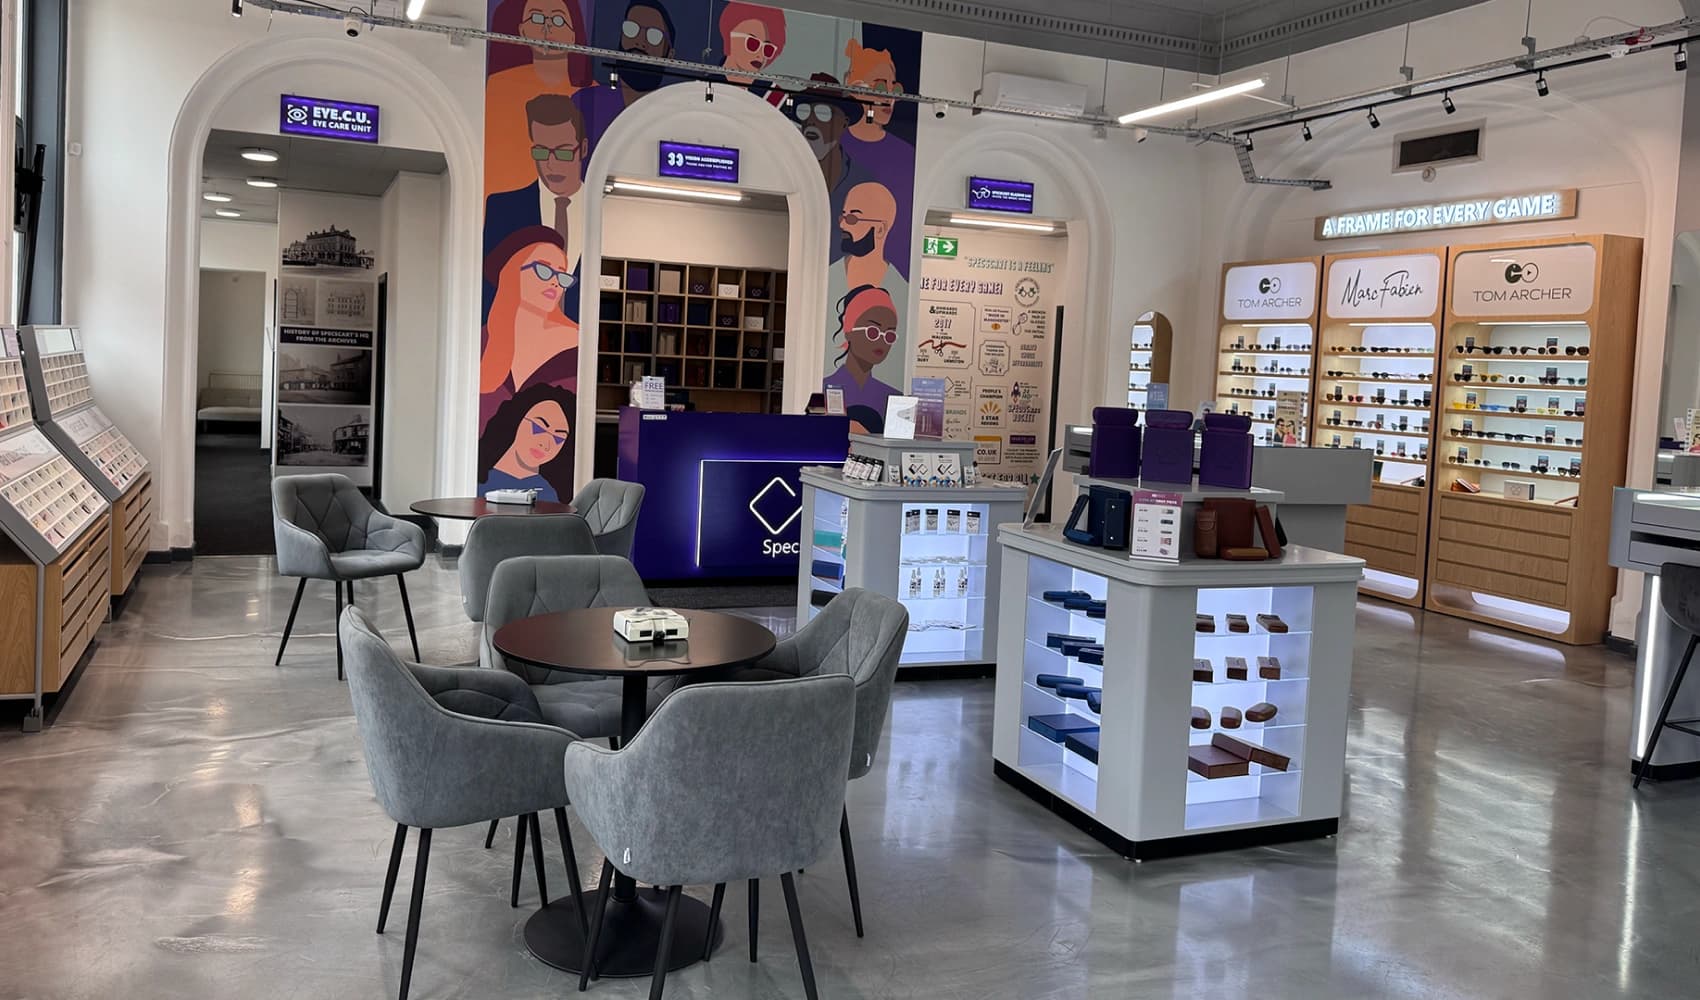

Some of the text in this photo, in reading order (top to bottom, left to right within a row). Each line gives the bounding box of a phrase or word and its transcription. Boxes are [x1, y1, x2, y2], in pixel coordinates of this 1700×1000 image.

[313, 119, 372, 133] EYE CARE UNIT
[1322, 194, 1556, 237] A FRAME FOR EVERY GAME
[1341, 269, 1424, 308] Marc Fabien
[1473, 287, 1572, 302] TOM ARCHER
[1238, 297, 1302, 309] TOM ARCHER
[644, 382, 664, 390] FREE
[762, 538, 800, 559] Spec
